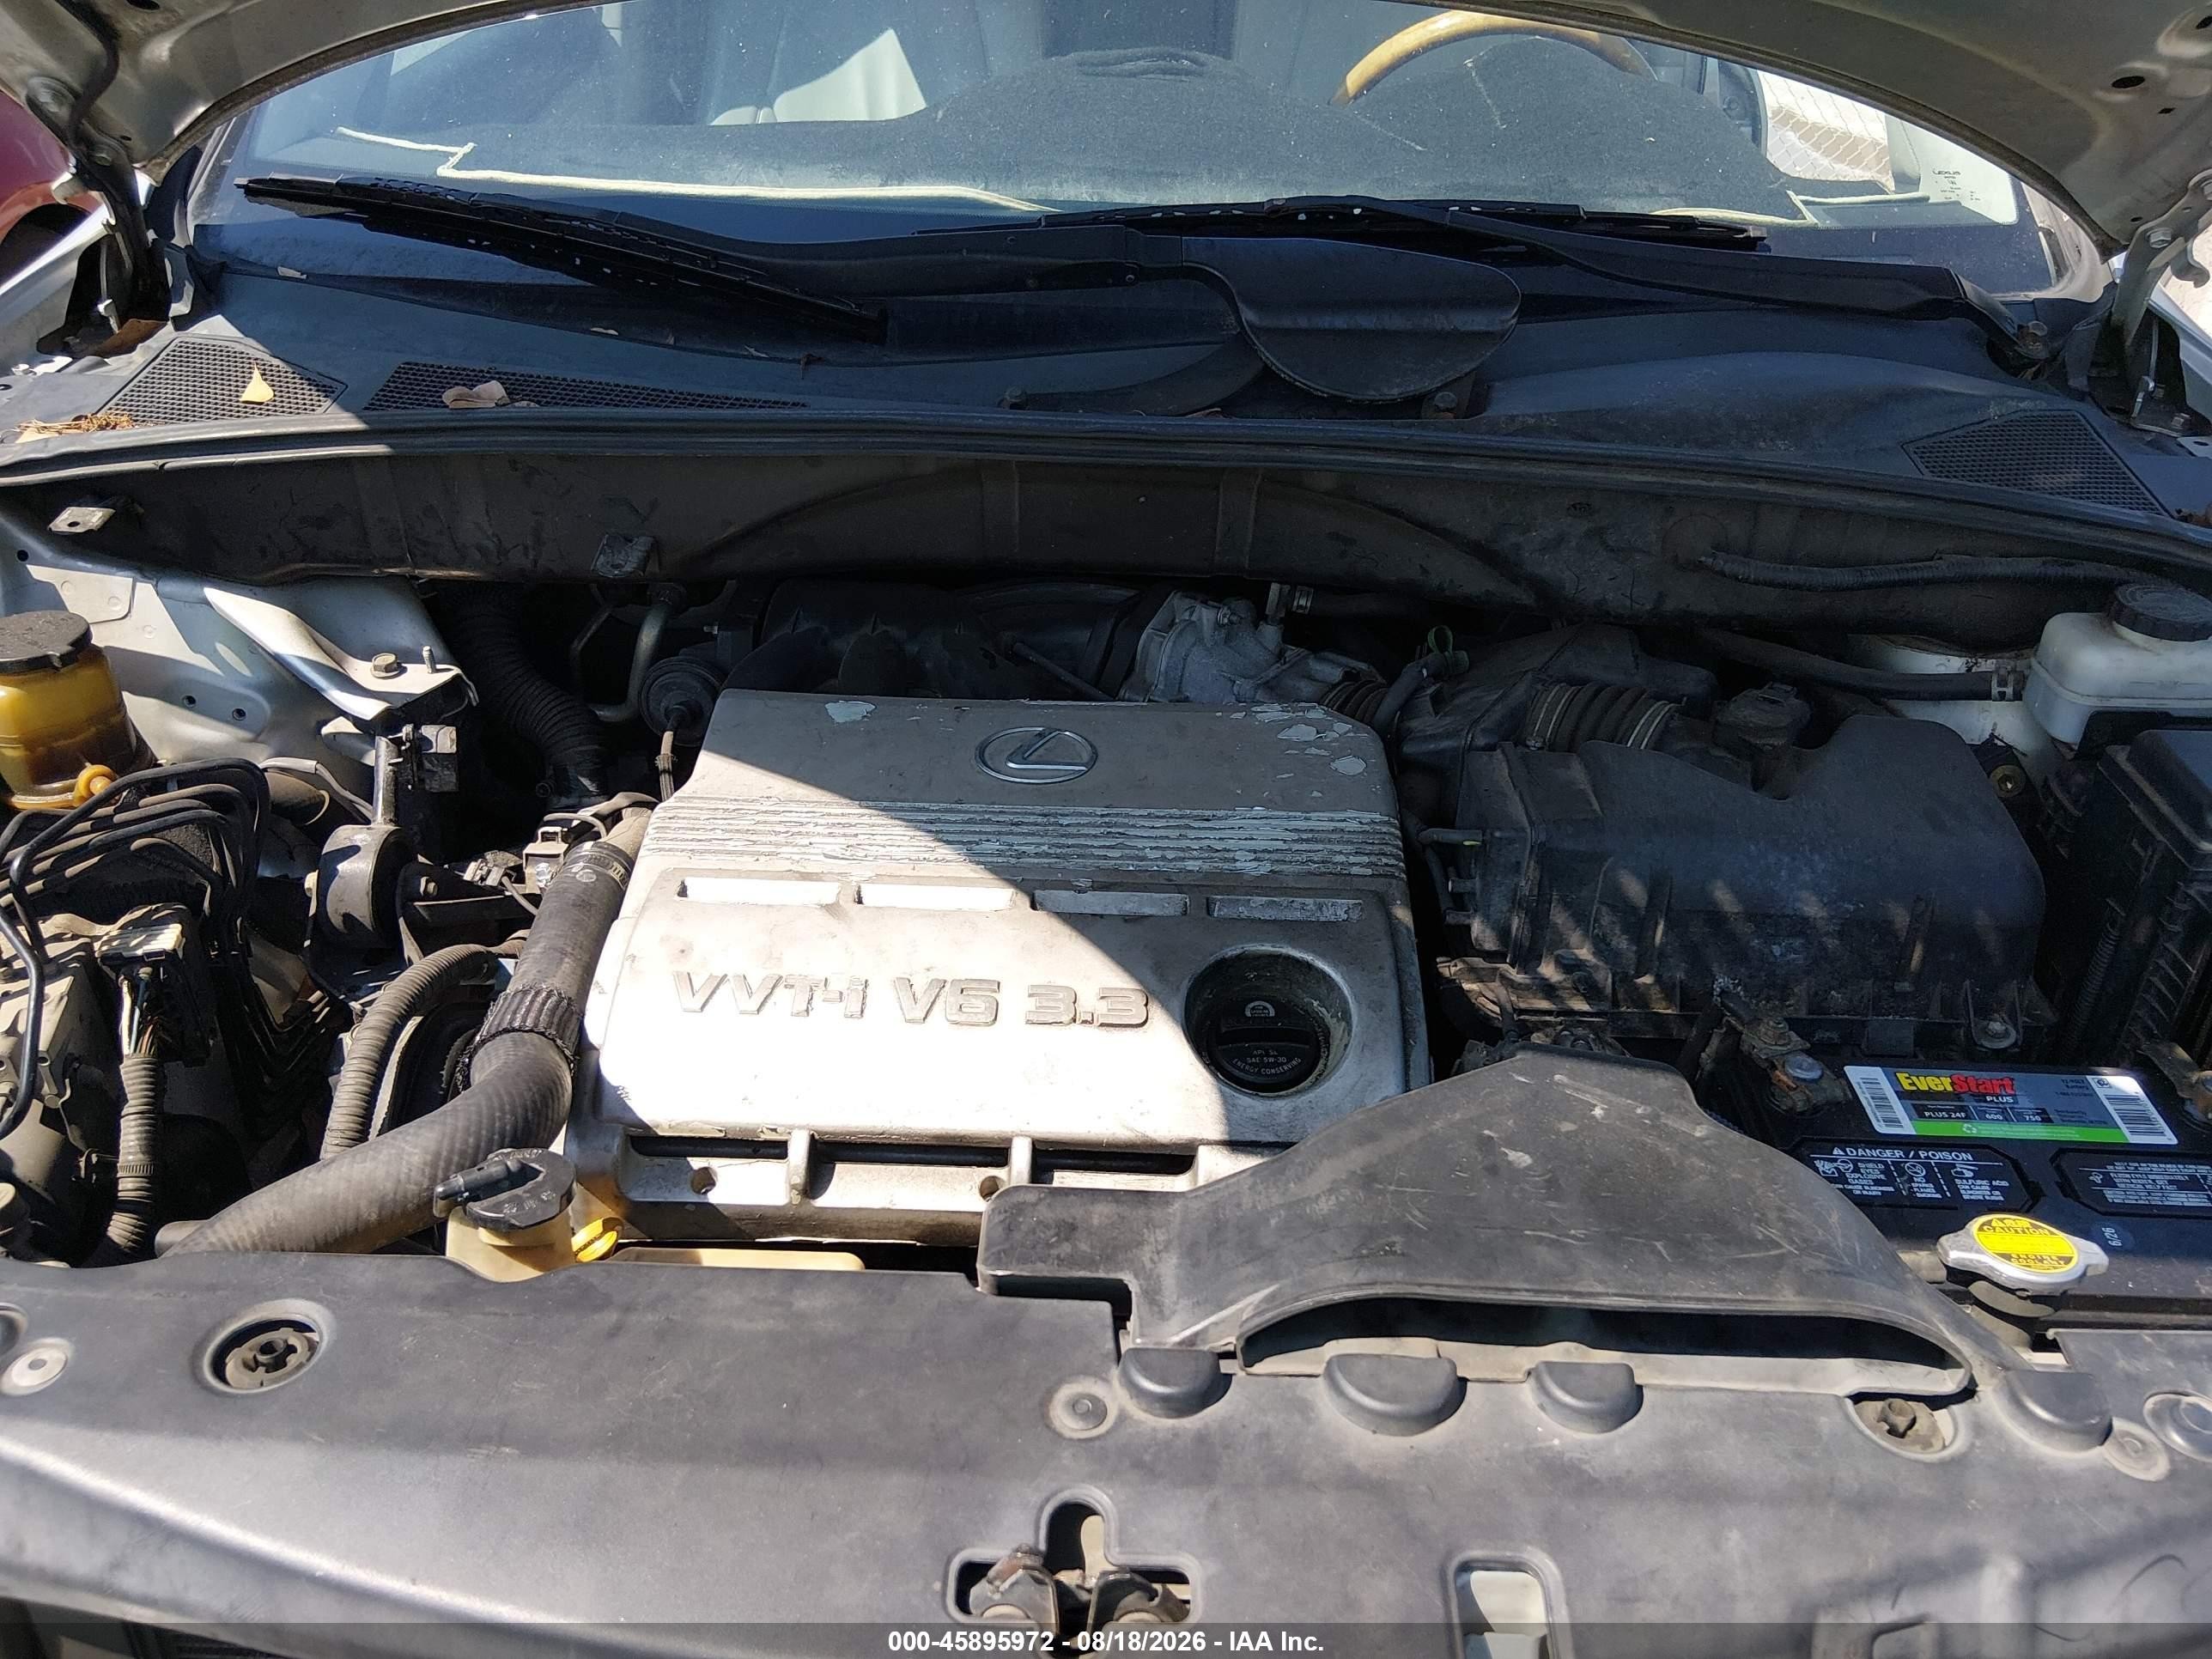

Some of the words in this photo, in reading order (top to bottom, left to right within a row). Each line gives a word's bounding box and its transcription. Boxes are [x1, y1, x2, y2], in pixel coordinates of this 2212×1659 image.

[894, 976, 1000, 1026] V6
[1025, 984, 1149, 1030] 3.3
[1232, 1058, 1259, 1073] ENERGY
[1261, 1057, 1302, 1075] CONSERVING
[1895, 1072, 2015, 1095] EverStart
[1845, 1148, 1904, 1158] DANGER
[1919, 1151, 1974, 1161] POISON
[1983, 1225, 2051, 1236] CAUTION
[2101, 1227, 2123, 1247] 6/26
